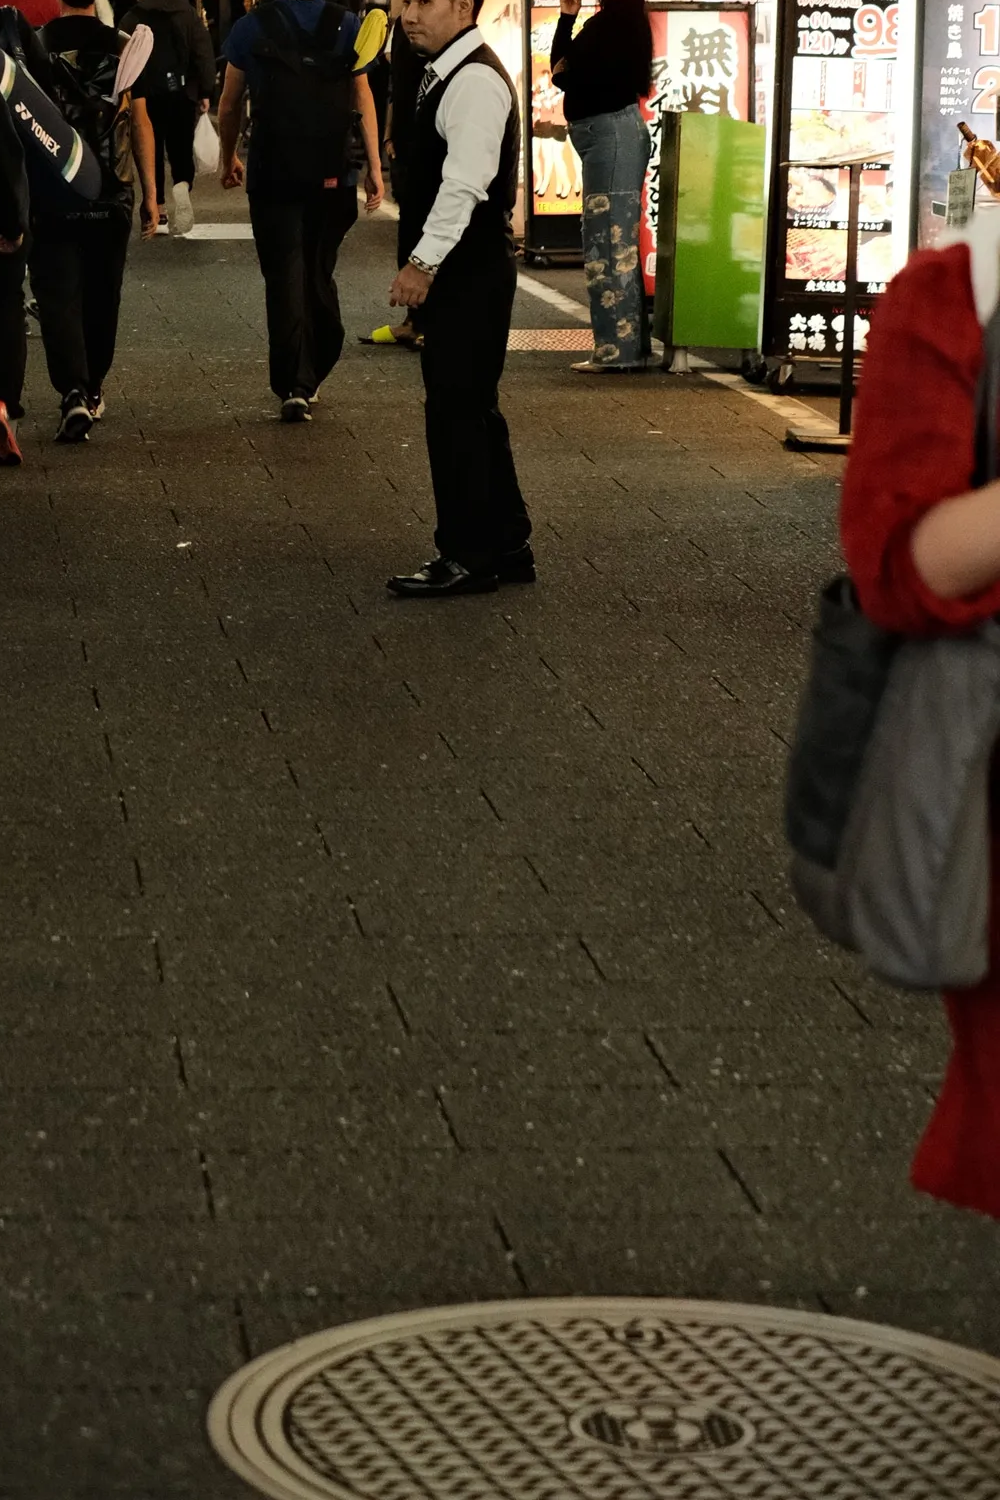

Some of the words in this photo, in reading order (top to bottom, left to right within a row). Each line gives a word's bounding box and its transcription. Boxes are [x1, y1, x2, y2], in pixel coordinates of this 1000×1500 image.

[946, 3, 965, 60] 焼き鳥
[940, 66, 971, 76] ハイボール
[30, 118, 61, 158] YONEX
